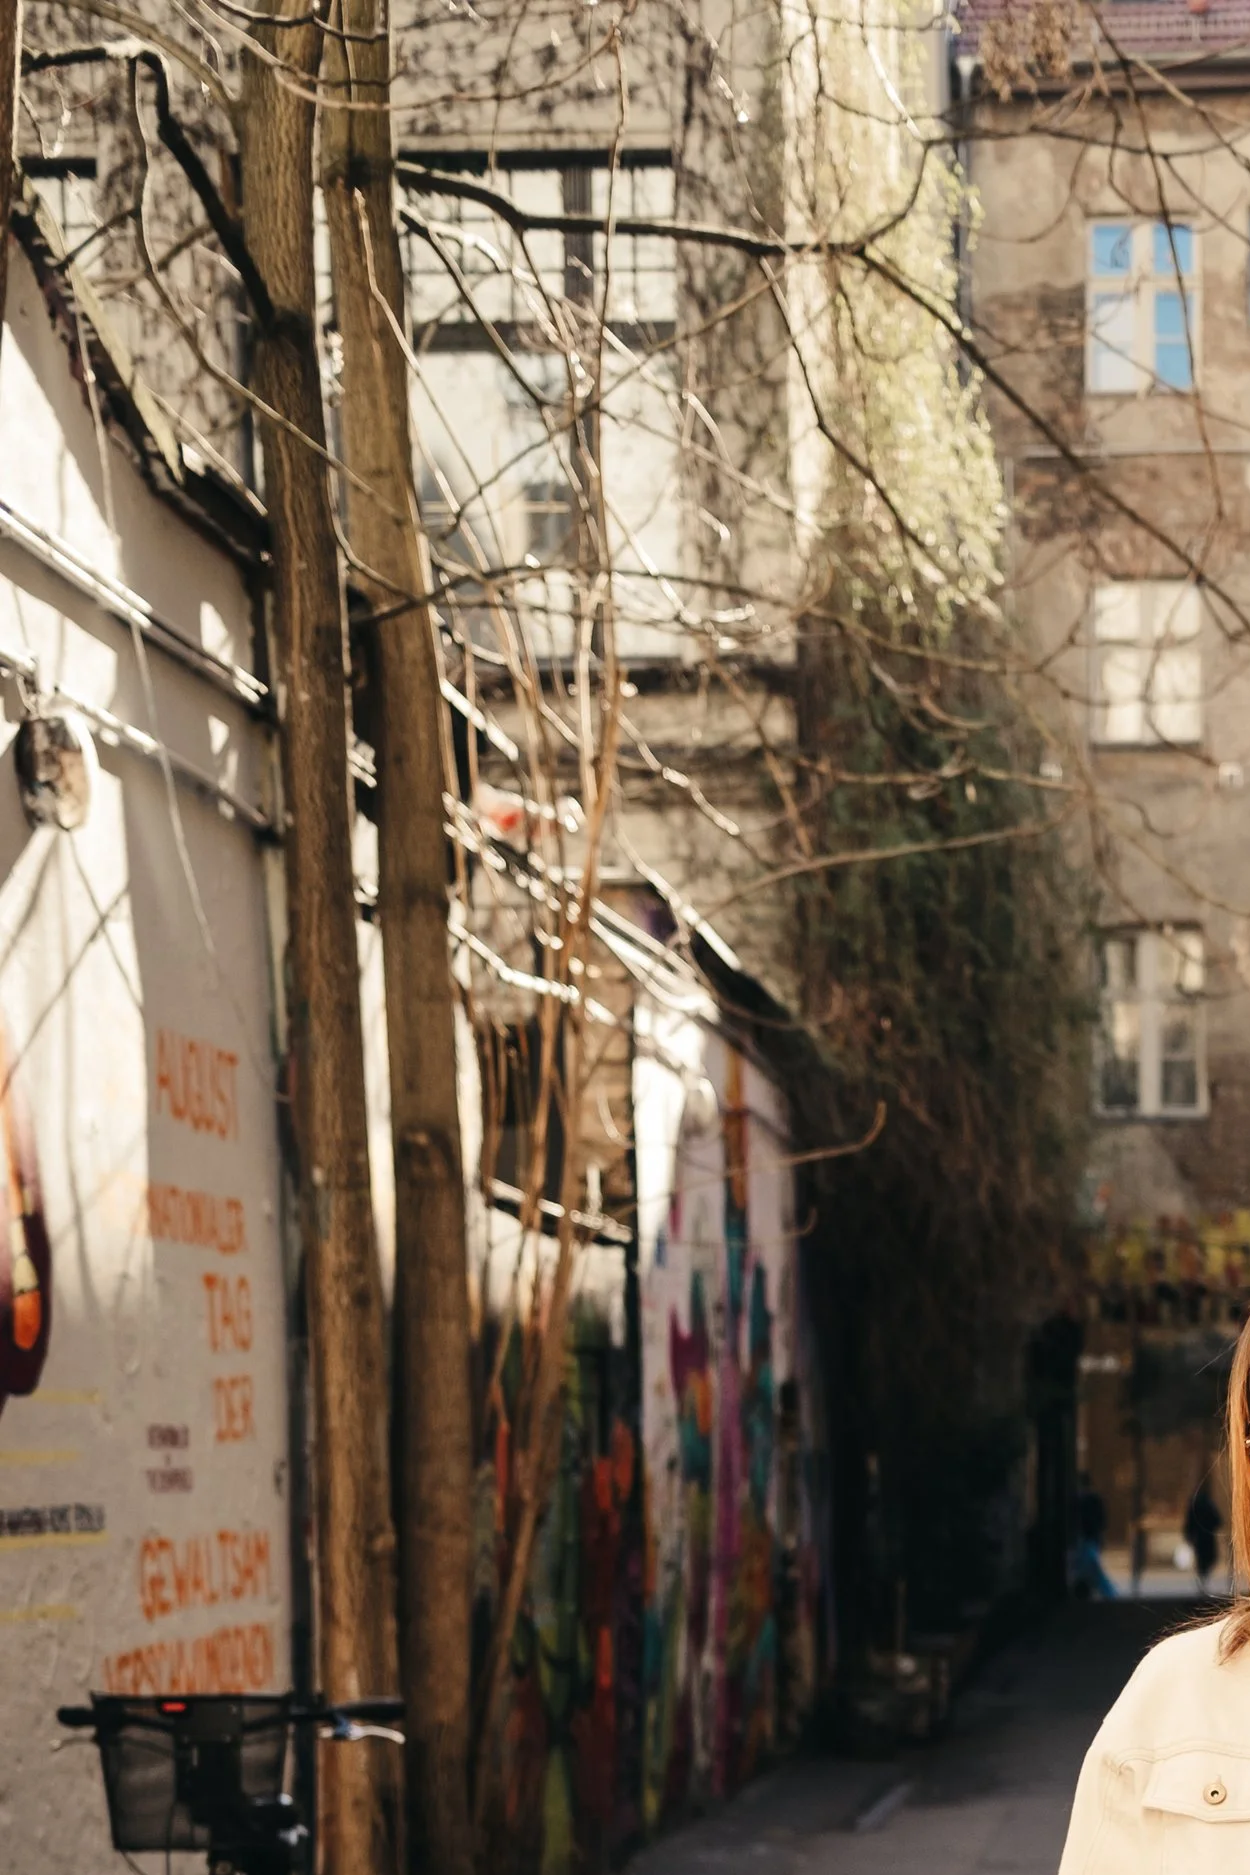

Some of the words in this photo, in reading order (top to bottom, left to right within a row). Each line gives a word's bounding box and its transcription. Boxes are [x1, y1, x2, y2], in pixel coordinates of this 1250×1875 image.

[155, 1028, 239, 1142] AUGUST
[202, 1270, 252, 1354] TAG
[211, 1373, 256, 1443] DER
[137, 1530, 271, 1622] GEWALTSAM
